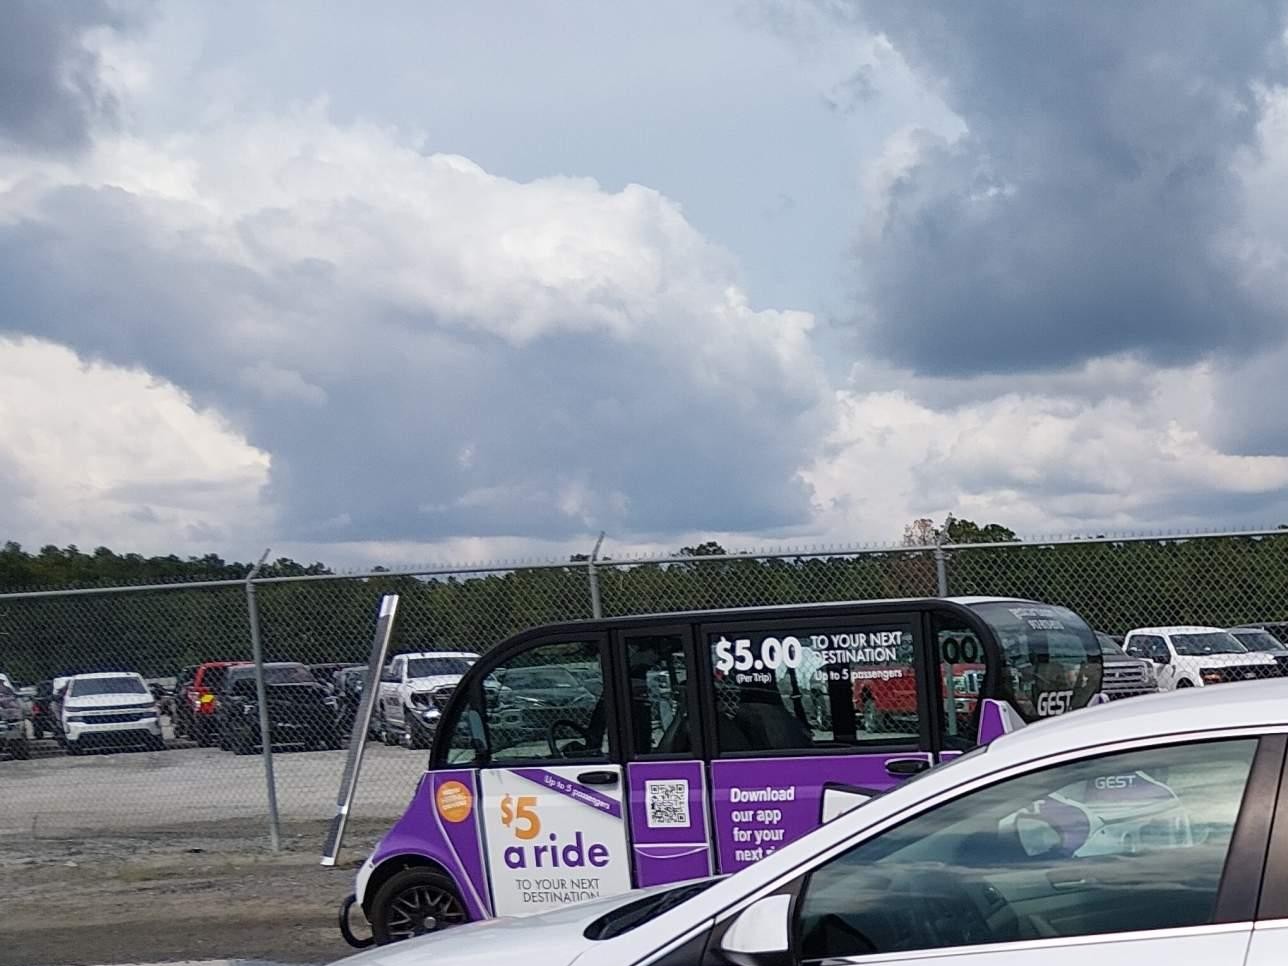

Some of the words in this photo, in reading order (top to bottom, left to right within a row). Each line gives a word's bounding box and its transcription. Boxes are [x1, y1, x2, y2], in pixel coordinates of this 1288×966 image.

[810, 635, 829, 649] TO
[830, 633, 867, 648] YOUR
[869, 631, 902, 645] NEXT
[715, 636, 801, 675] $5.00
[813, 648, 897, 664] DESTINATION
[736, 673, 752, 683] (Per
[754, 671, 772, 683] Trip)
[815, 671, 828, 683] Up
[830, 671, 840, 680] to
[842, 668, 849, 679] 5
[851, 669, 903, 681] passengers
[1037, 690, 1073, 716] GEST
[1095, 775, 1136, 789] GEST
[730, 787, 795, 803] Download
[501, 793, 541, 840] $5
[731, 810, 754, 823] our
[756, 809, 782, 825] app
[733, 828, 752, 842] for
[754, 829, 785, 845] your
[504, 845, 527, 869] a
[534, 831, 610, 868] ride
[735, 847, 763, 861] next
[515, 879, 532, 890] TO
[535, 879, 567, 889] YOUR
[571, 878, 600, 889] NEXT
